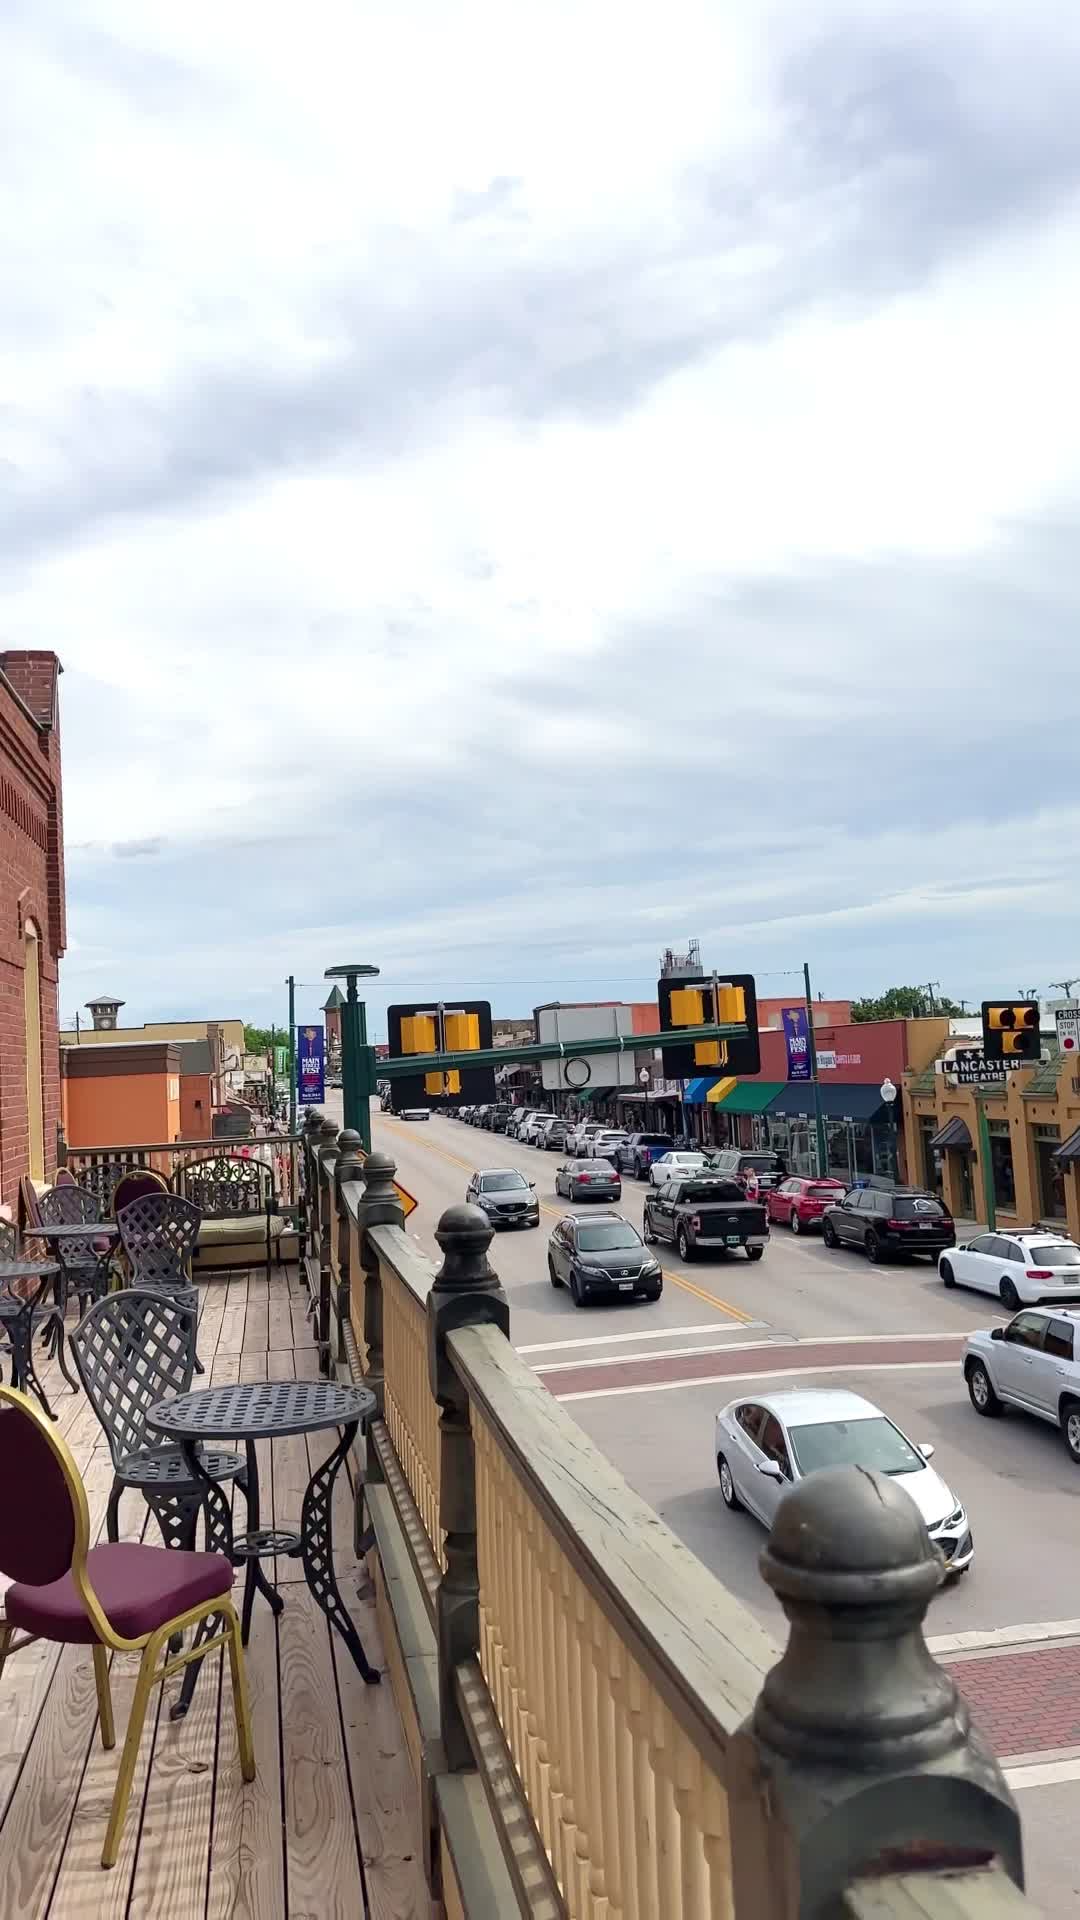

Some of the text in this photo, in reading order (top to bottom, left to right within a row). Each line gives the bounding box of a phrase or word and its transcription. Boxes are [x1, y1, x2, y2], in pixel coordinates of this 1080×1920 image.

[1059, 1021, 1075, 1029] STOP
[943, 1059, 1020, 1073] LANCASTER
[960, 1072, 1006, 1082] THEATRE
